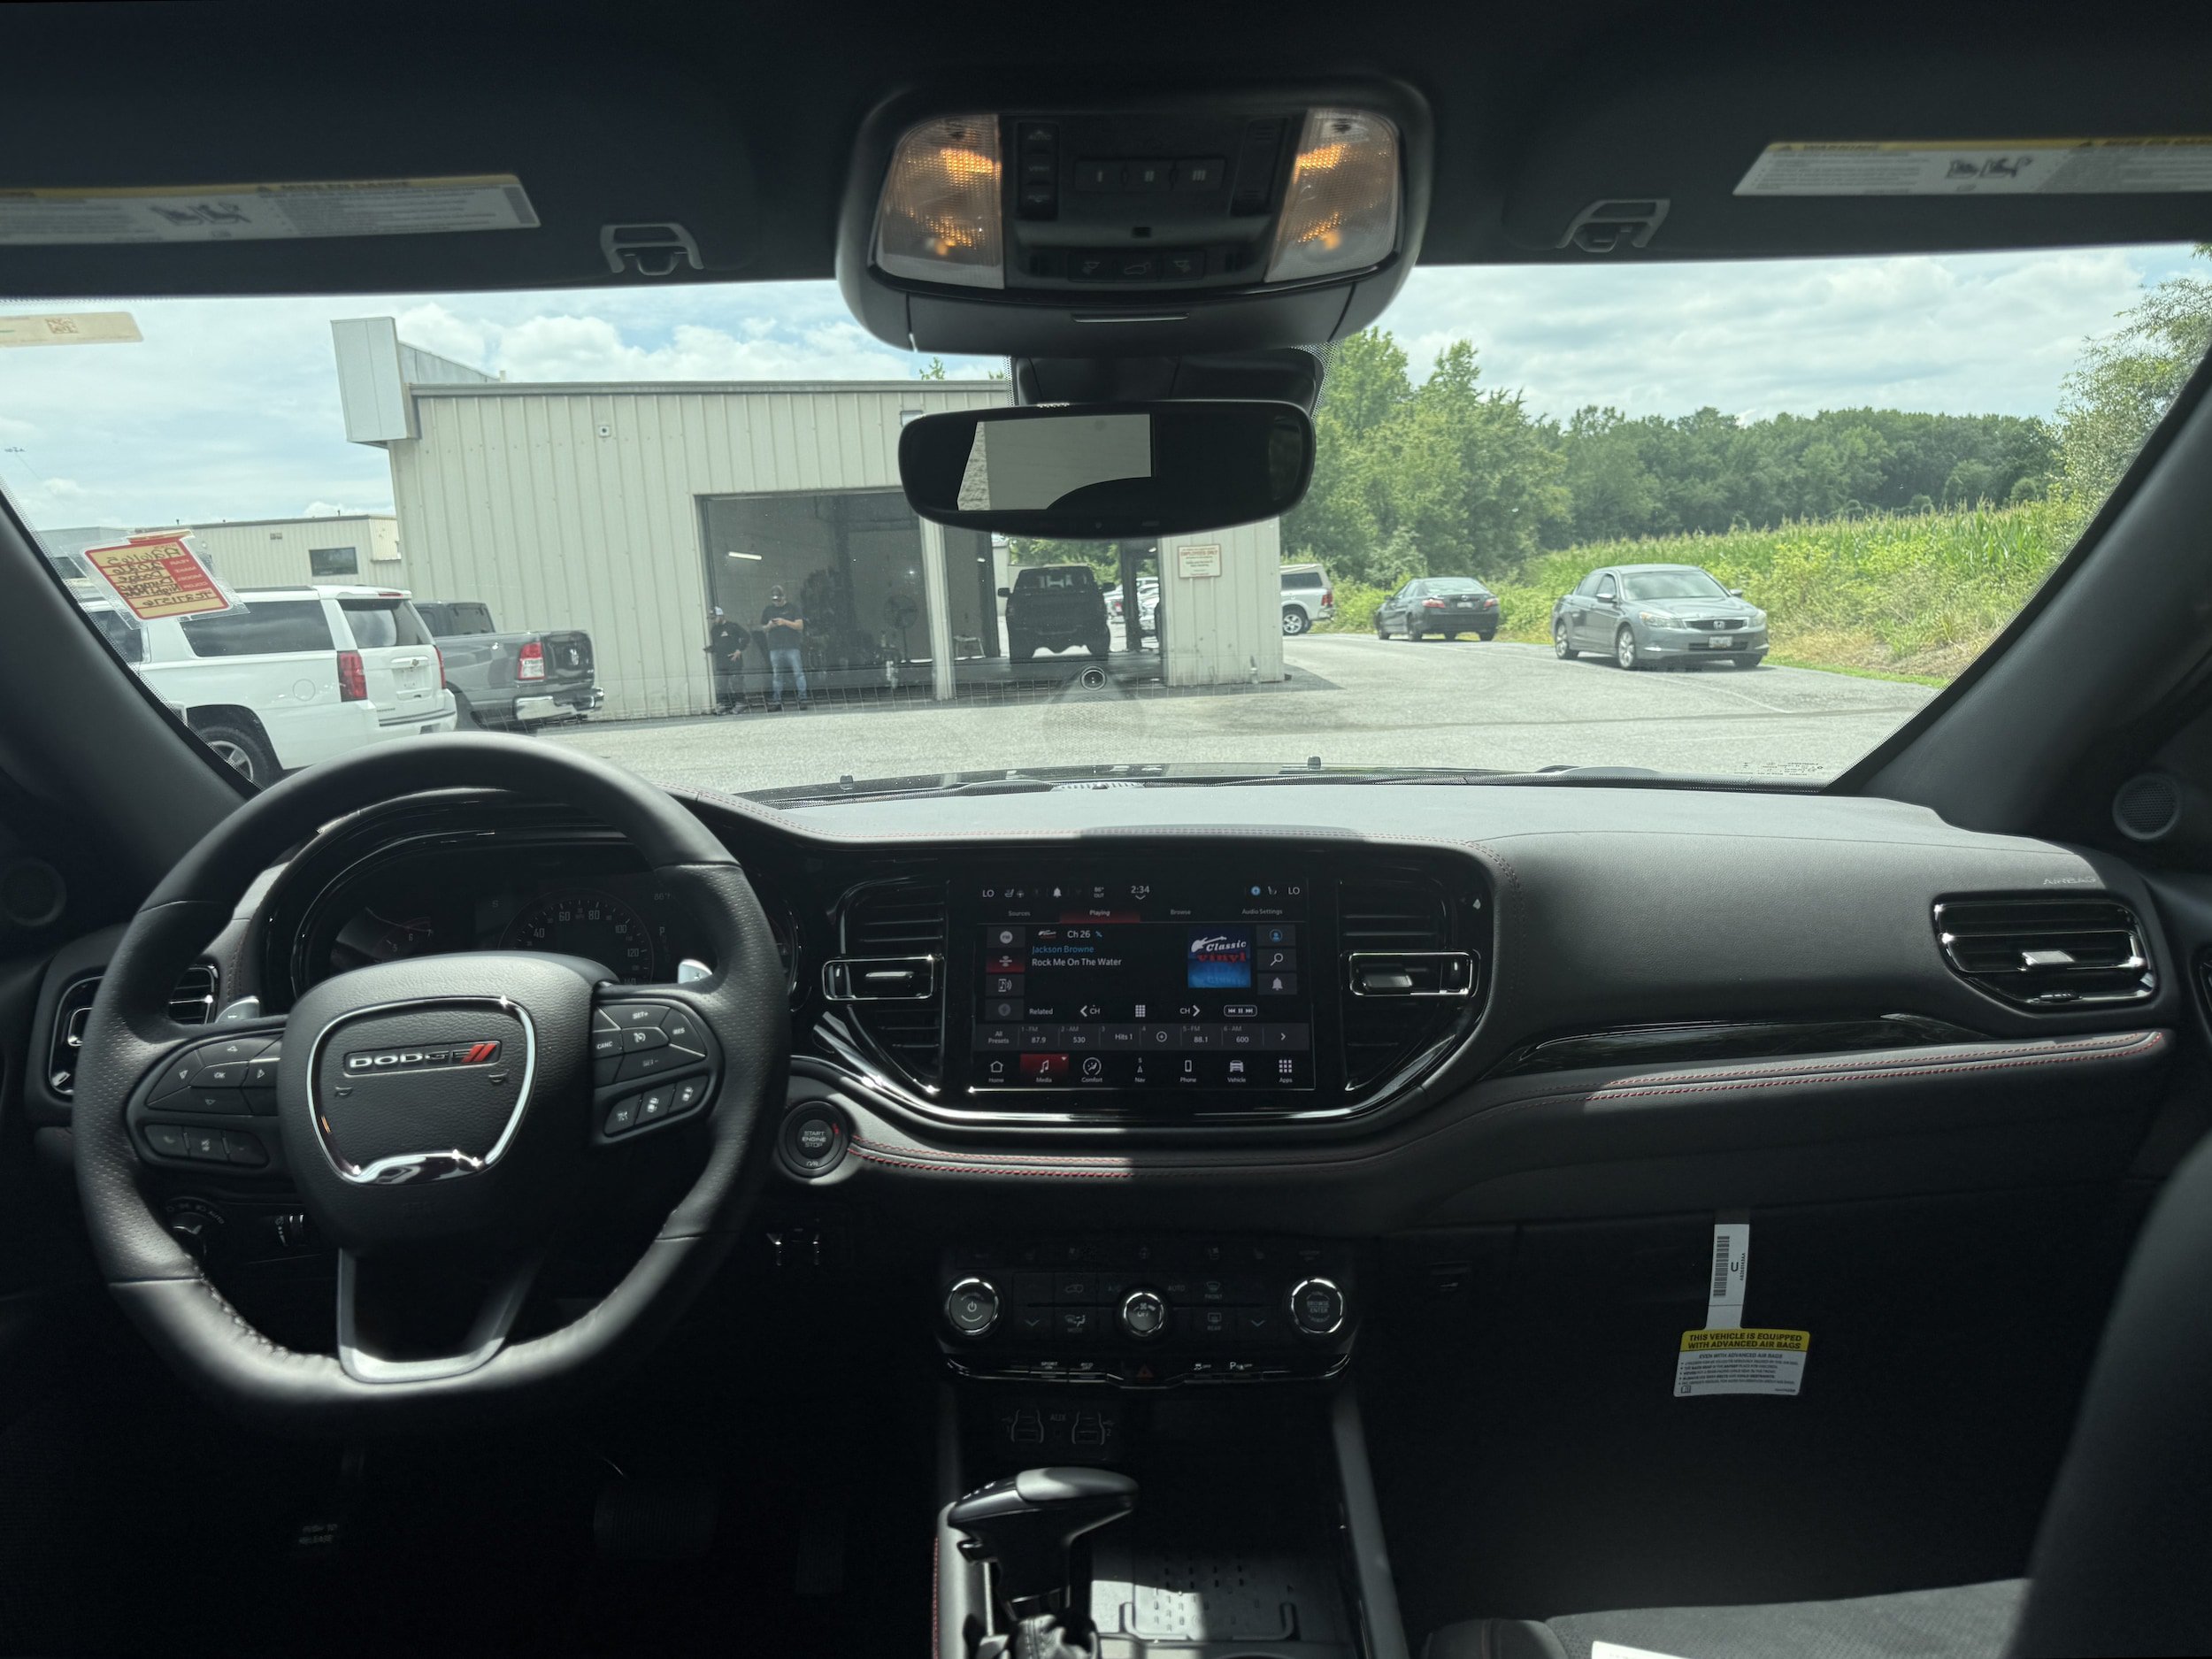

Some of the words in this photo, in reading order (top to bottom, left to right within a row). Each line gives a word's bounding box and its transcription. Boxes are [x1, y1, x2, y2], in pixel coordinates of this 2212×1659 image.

[981, 889, 995, 898] LO
[1131, 885, 1149, 895] 2:34
[1287, 886, 1301, 895] LO
[559, 911, 571, 921] 60
[588, 910, 600, 920] 80
[1067, 930, 1079, 940] Ch
[1080, 930, 1090, 940] 26
[1032, 946, 1062, 956] Jackson
[1064, 946, 1094, 955] Browne
[1205, 940, 1248, 953] Classic
[626, 949, 640, 957] 120
[1032, 957, 1051, 967] Rock
[1081, 957, 1096, 966] The
[1097, 957, 1122, 966] Water
[349, 1048, 472, 1069] DODGE
[1731, 1262, 1740, 1272] U
[1757, 1333, 1802, 1341] EQUIPPED
